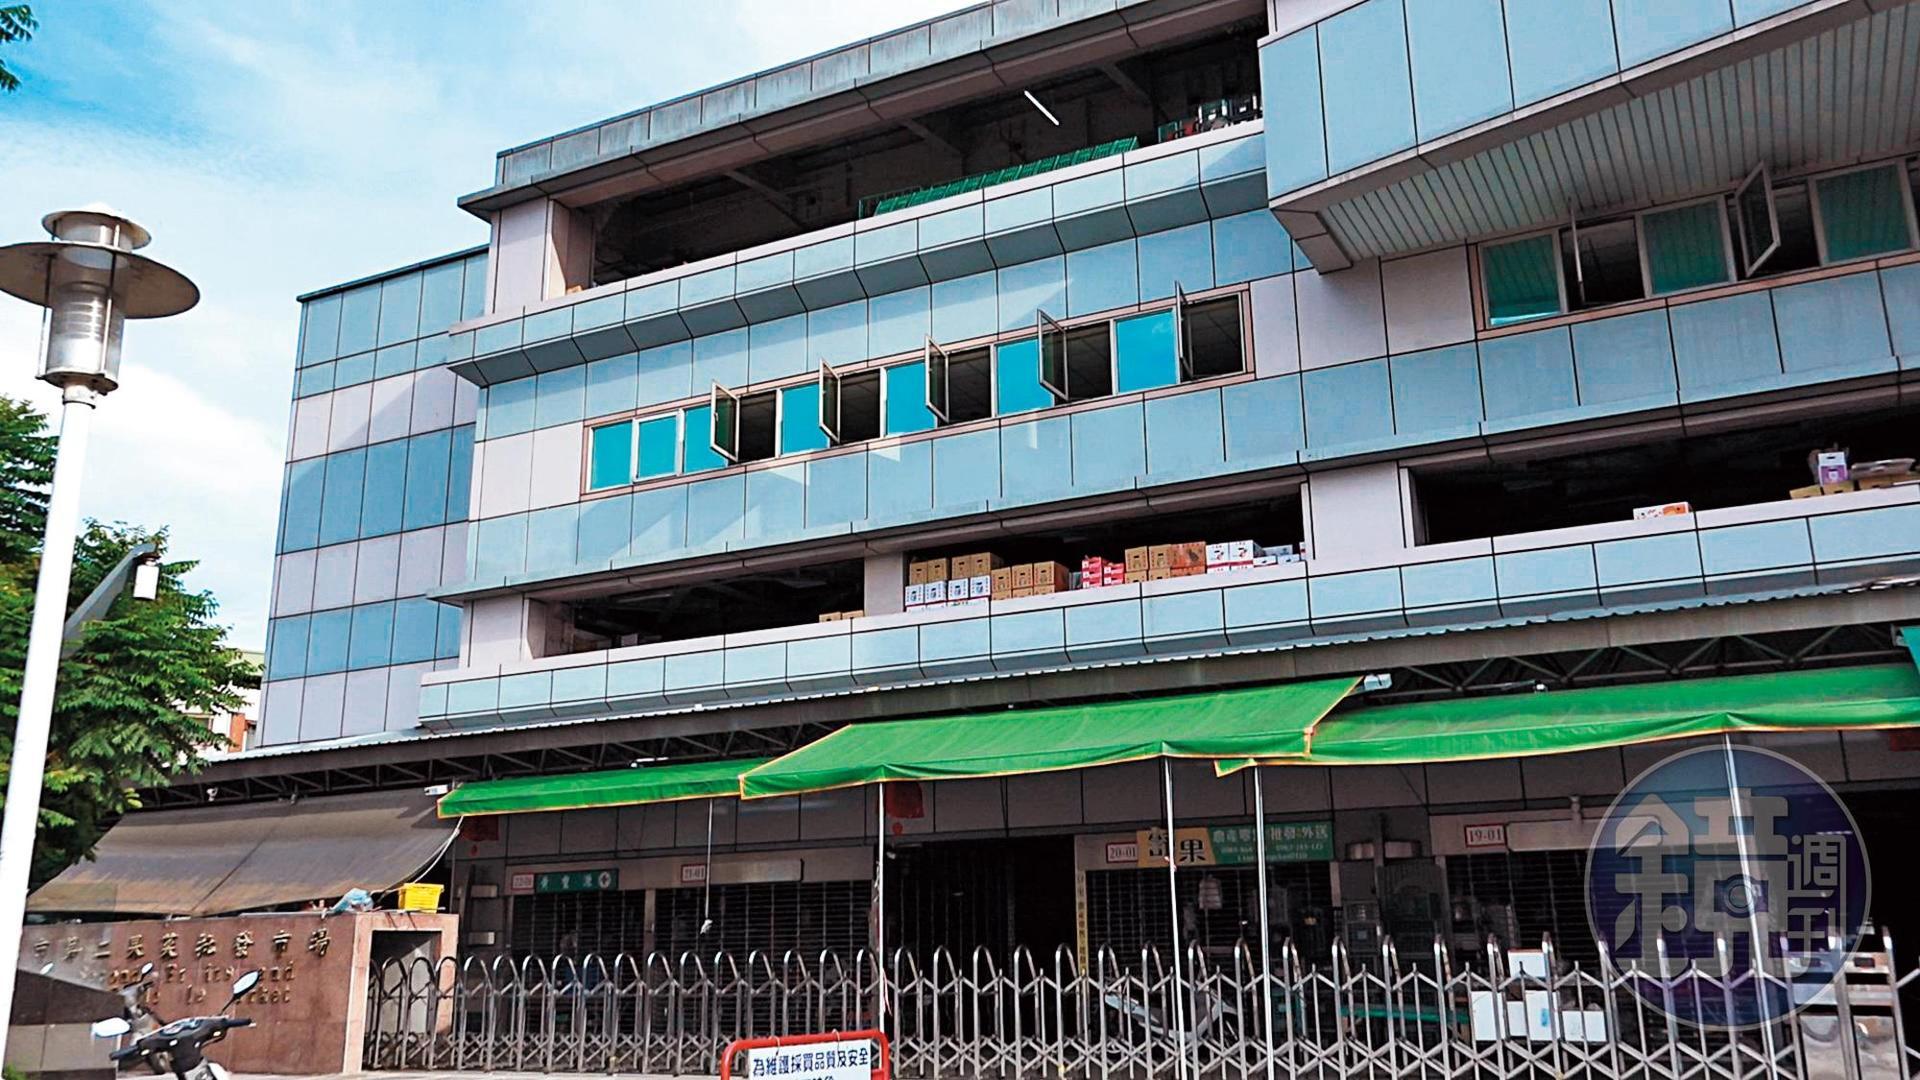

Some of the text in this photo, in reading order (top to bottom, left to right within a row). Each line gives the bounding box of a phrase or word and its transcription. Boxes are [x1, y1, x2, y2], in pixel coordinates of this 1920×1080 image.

[1469, 828, 1501, 842] 19-01
[1109, 845, 1136, 860] 20-01
[752, 1047, 869, 1077] 為維護採買品質及安全
